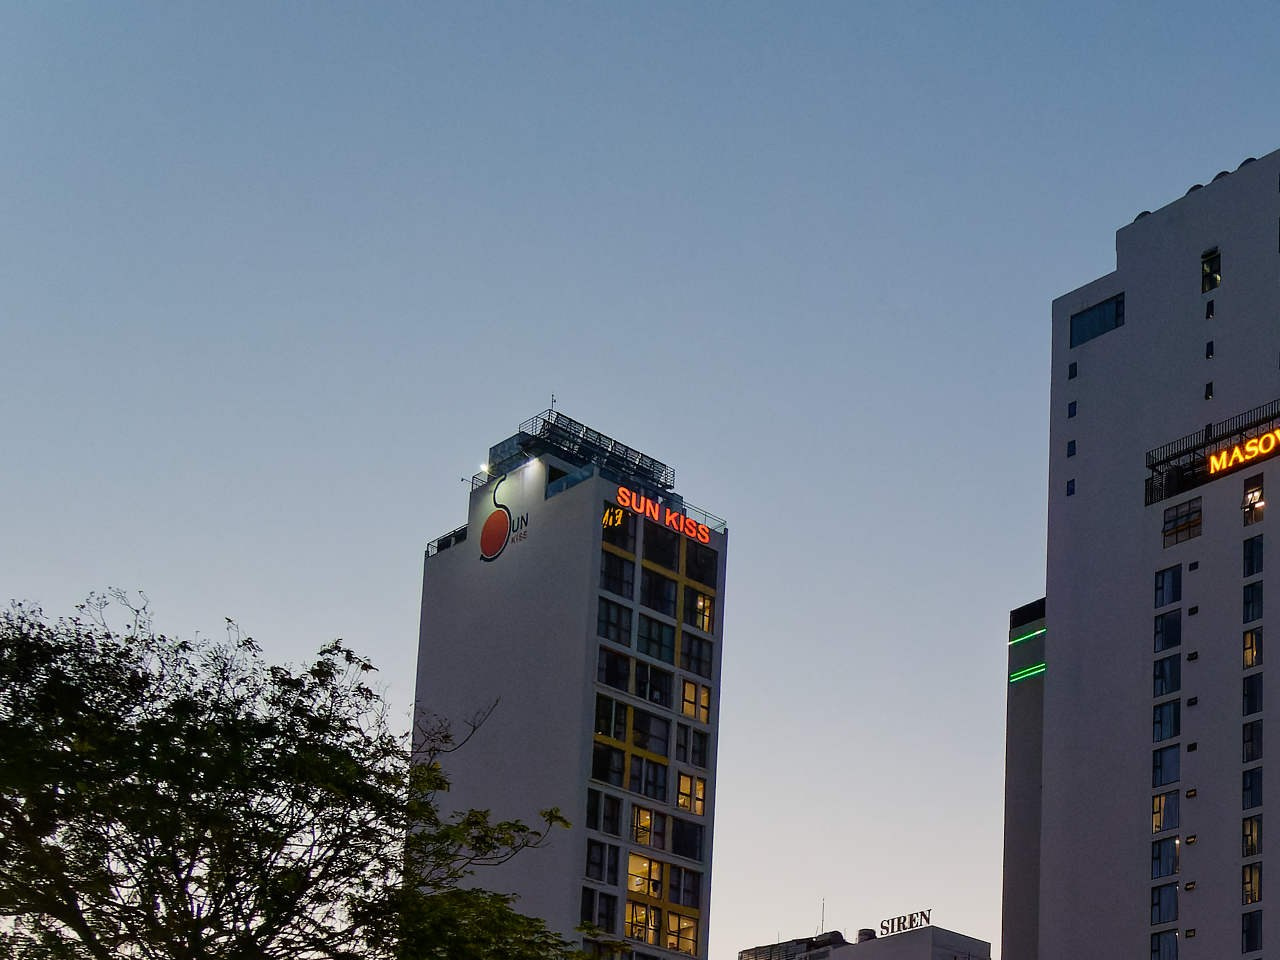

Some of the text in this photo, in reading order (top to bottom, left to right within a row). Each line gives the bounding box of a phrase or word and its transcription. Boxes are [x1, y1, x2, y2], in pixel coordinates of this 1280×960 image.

[617, 486, 660, 521] SUN
[665, 508, 710, 544] KISS
[880, 909, 932, 936] SIREN
